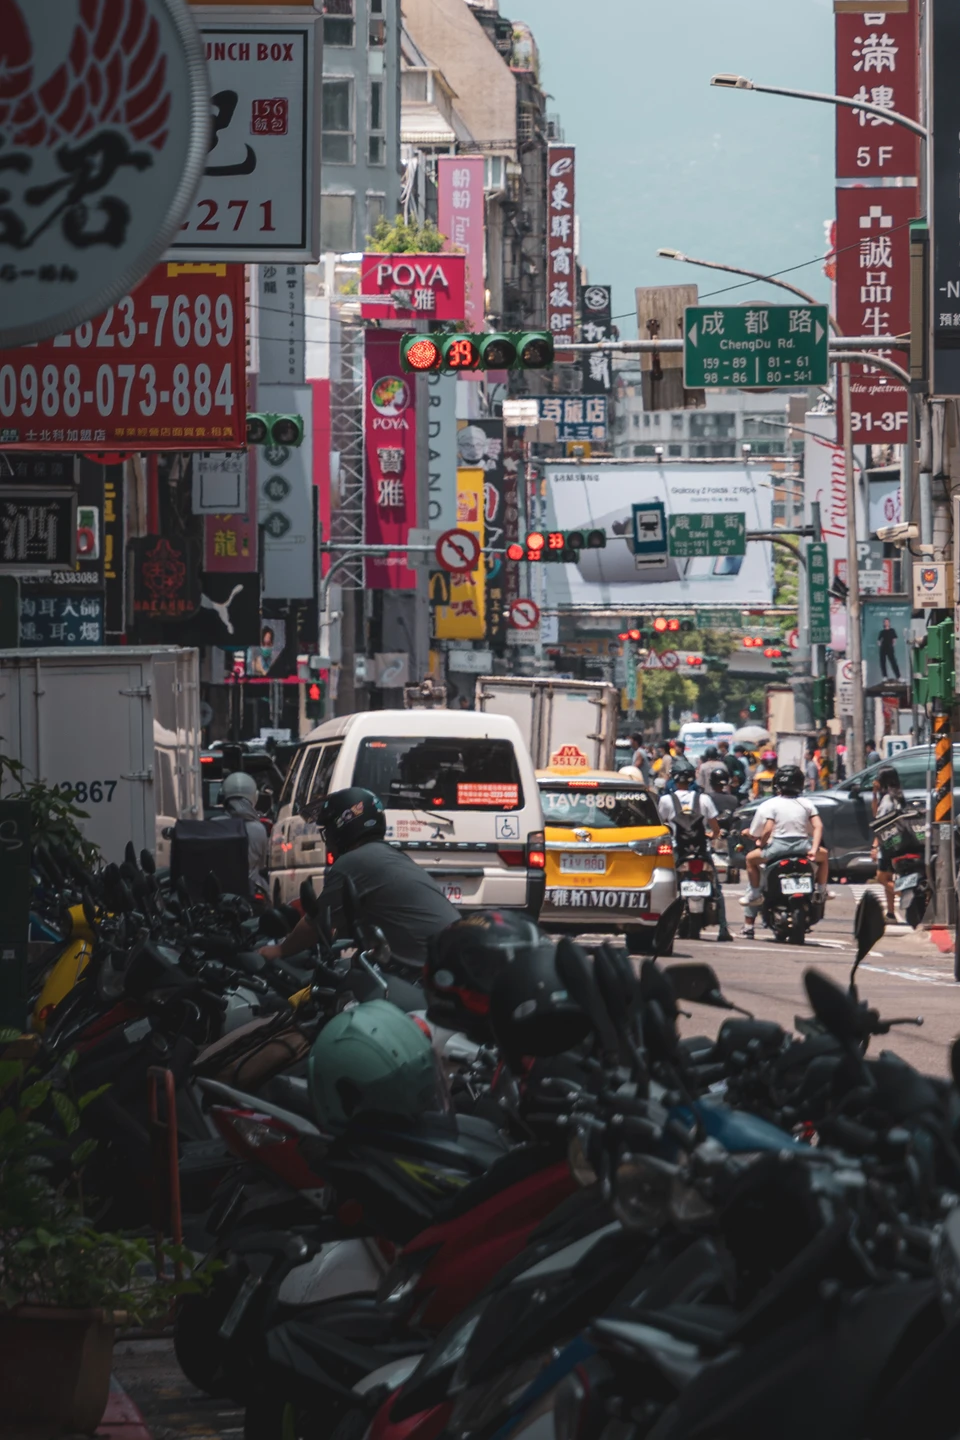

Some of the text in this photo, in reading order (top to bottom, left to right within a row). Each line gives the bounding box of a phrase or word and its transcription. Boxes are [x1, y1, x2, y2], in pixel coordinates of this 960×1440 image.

[203, 42, 294, 62] UNCH BOX
[252, 100, 285, 116] 156
[376, 264, 449, 287] POYA
[701, 310, 813, 335] 成都路
[449, 339, 472, 367] 39
[719, 338, 796, 352] ChengDu Rd.
[0, 362, 235, 418] 0988-073-884
[372, 417, 409, 431] POYA
[376, 446, 405, 507] 寶雅
[564, 746, 575, 756] M
[552, 756, 587, 766] 55178
[588, 891, 648, 909] MOTEL
